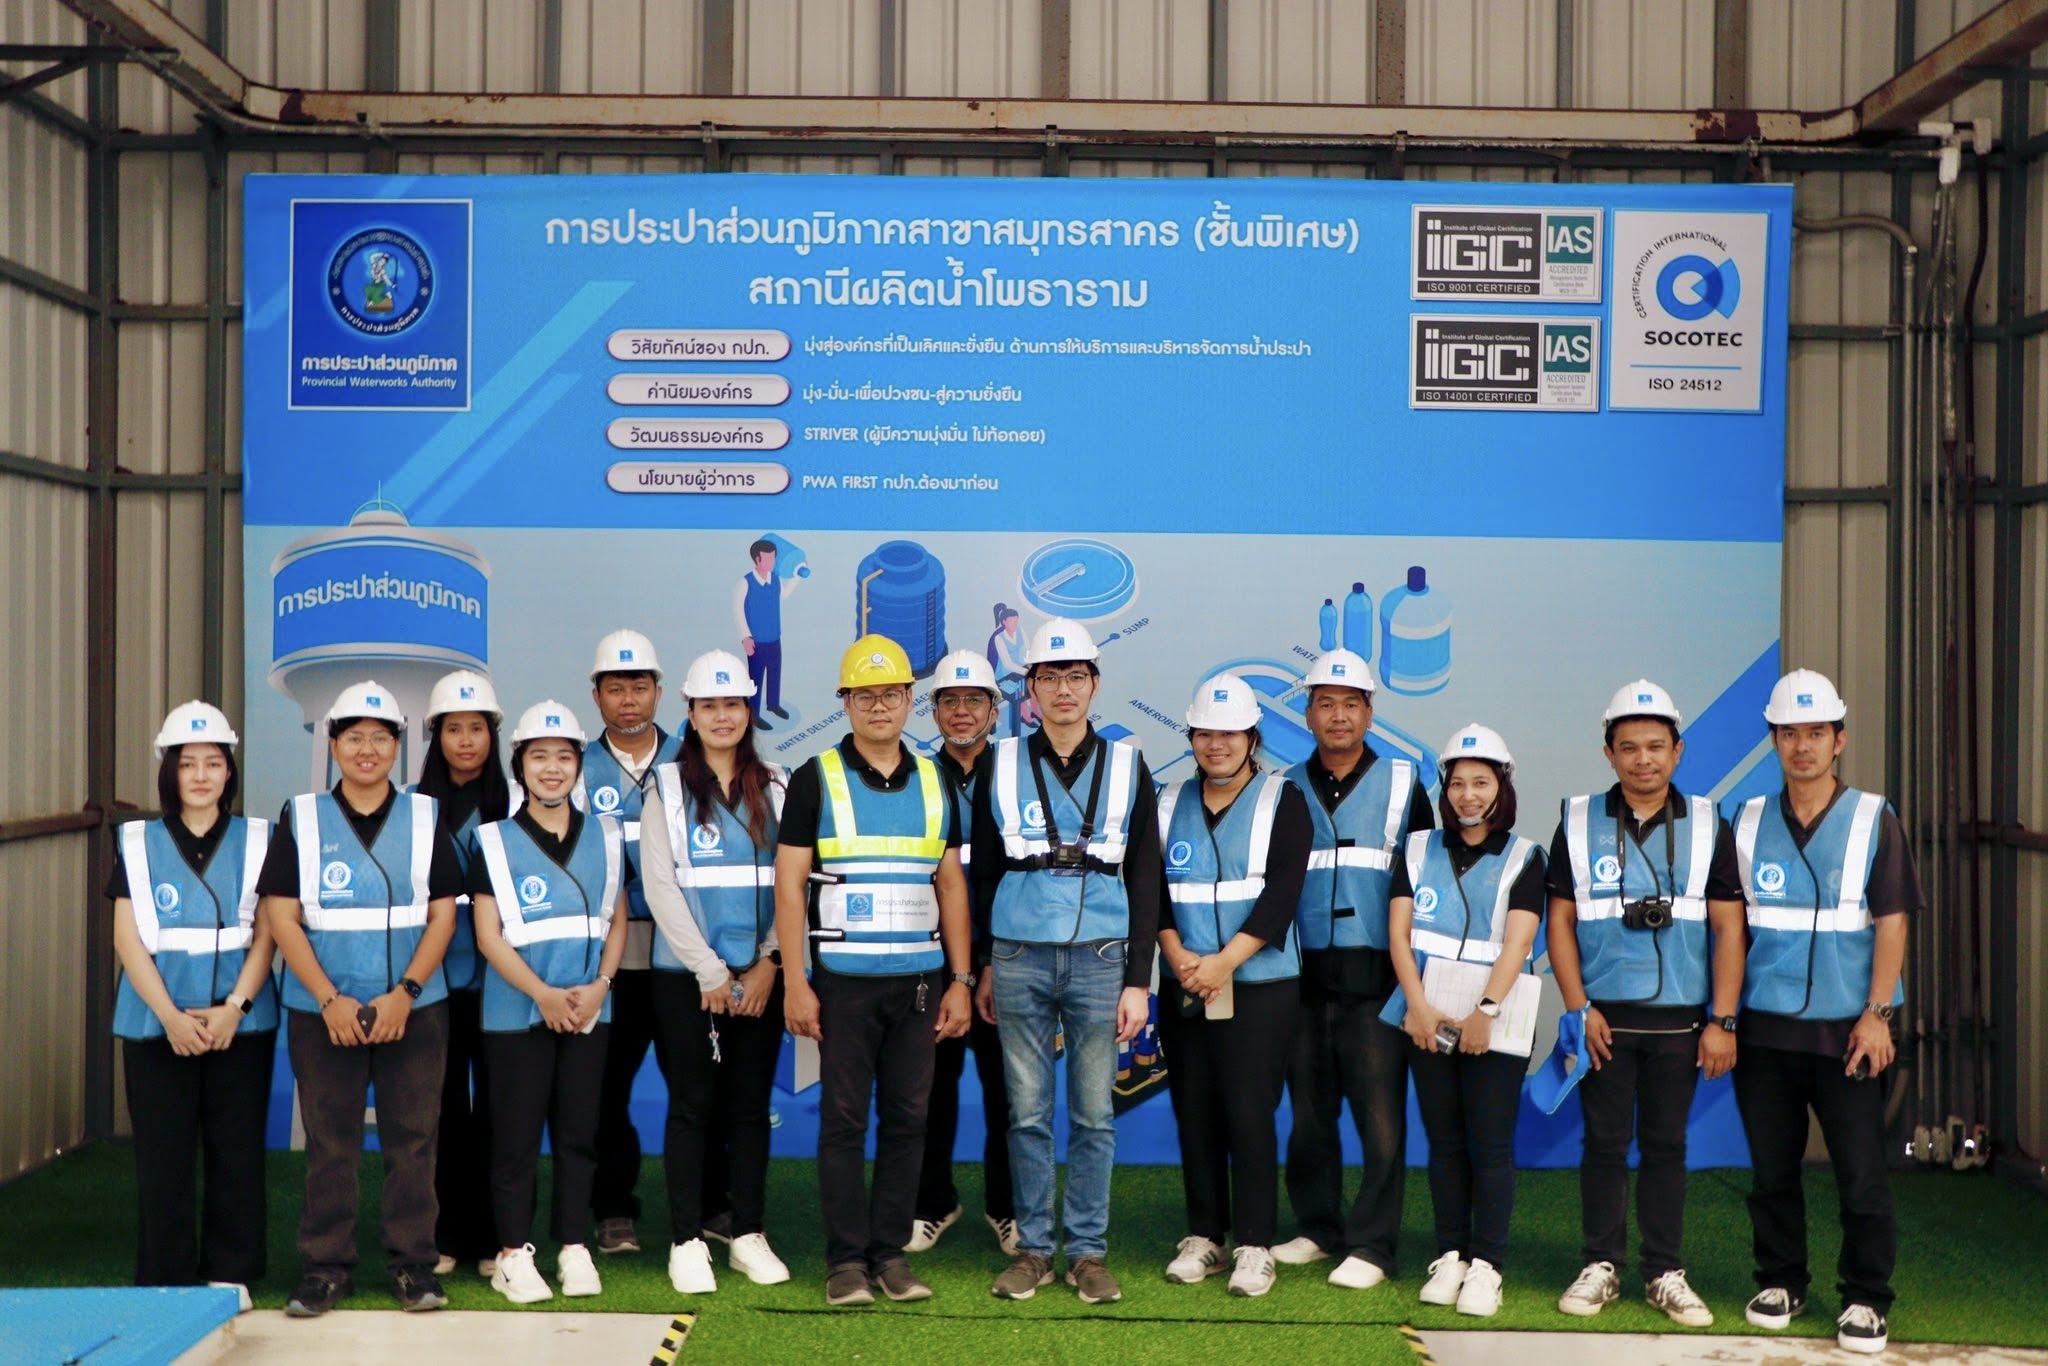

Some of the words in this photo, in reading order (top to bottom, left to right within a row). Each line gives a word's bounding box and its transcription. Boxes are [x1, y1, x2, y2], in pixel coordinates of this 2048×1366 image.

[545, 206, 1179, 256] การประปาส่วนภูมิภาคสาขาสมุทรสาคร
[1194, 201, 1359, 253] (ชั้นพิเศษ)
[1547, 225, 1593, 254] IAS
[749, 257, 1148, 307] สถานีผลิตน้ำโพธาราม
[1632, 249, 1654, 319] CERTIFICATION
[1653, 231, 1728, 252] INTERNATIONAL
[1427, 282, 1445, 292] ISO
[1449, 283, 1472, 292] 9001
[1476, 283, 1531, 293] CERTIFIED
[631, 338, 726, 355] วิสัยทัศน์ของ
[732, 339, 770, 355] กปภ.
[804, 332, 1005, 357] มุ่งสู่องค์กรที่เป็นเลิศและยั่งยืน
[1010, 335, 1312, 357] ด้านการให้บริการและบริหารจัดการน้ำประปา
[1545, 335, 1590, 363] IAS
[1644, 331, 1743, 347] SOCOTEC
[302, 354, 458, 375] การประปาส่วนภูมิภาค
[302, 376, 347, 387] Provincial
[350, 377, 408, 388] Waterworks
[411, 377, 457, 391] Authority
[647, 382, 752, 399] ค่านิยมองค์กร
[803, 380, 1022, 406] มุ่ง-มั่น-เพื่อปวงชน-สู่ความยั่งยืน
[1649, 378, 1674, 390] ISO
[1680, 379, 1722, 391] 24512
[1422, 391, 1441, 400] ISO
[1445, 391, 1473, 401] 14001
[1477, 392, 1532, 402] CERTIFIED
[630, 426, 764, 444] วัฒนธรรมองค์กร
[804, 427, 859, 441] STRIVER
[863, 421, 969, 446] (ผู้มีความมุ่งมั่น
[972, 425, 1046, 445] ไม่ท้อถอย)
[638, 469, 755, 491] นโยบายผู้ว่าการ
[802, 475, 837, 489] PWA
[843, 475, 878, 489] FIRST
[883, 473, 999, 491] กปภ.ต้องมาก่อน
[278, 571, 481, 619] การประปาส่วนภูมิภาค
[1122, 617, 1150, 636] SUMP
[1292, 644, 1319, 663] WATE
[1128, 699, 1182, 731] ANAEROBIC
[775, 730, 809, 752] WATER
